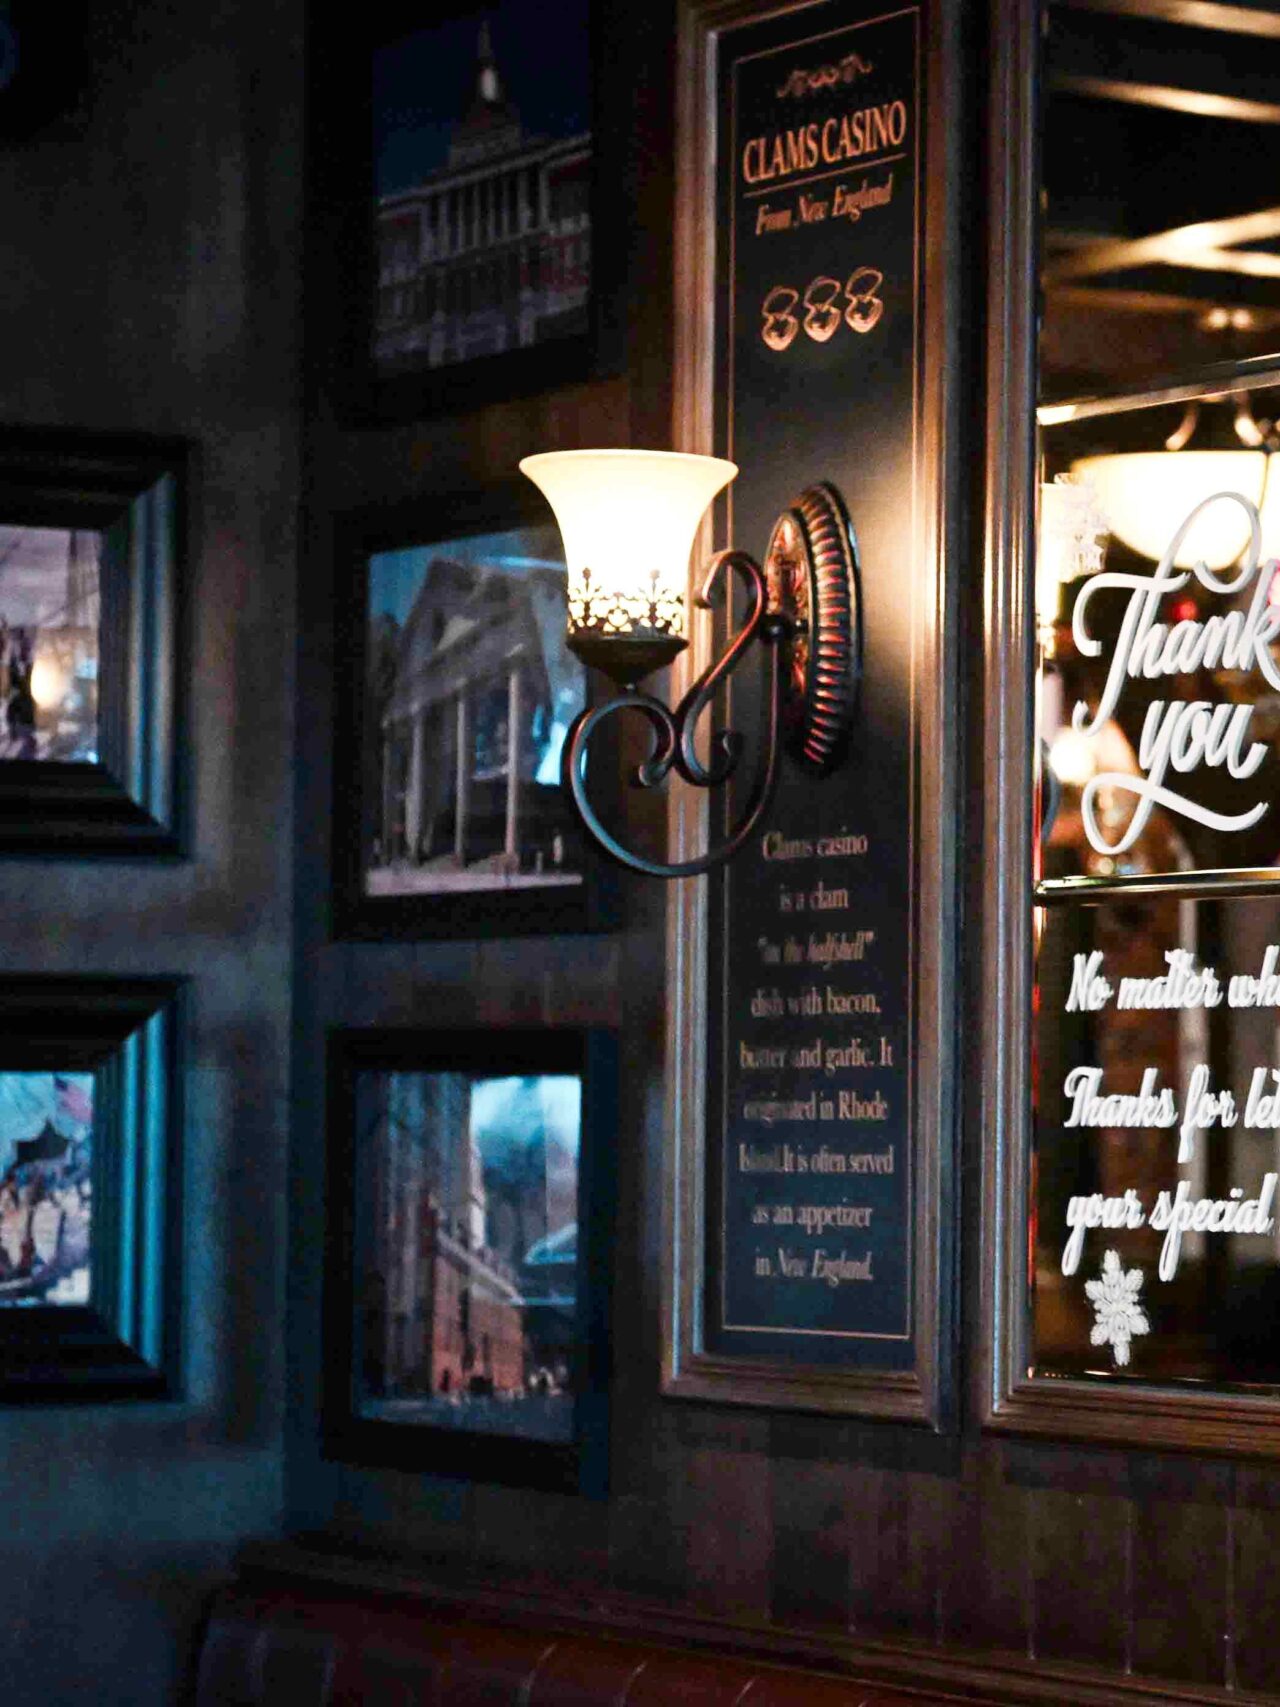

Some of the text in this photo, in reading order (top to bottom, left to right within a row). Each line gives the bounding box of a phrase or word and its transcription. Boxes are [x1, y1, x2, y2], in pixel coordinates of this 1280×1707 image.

[743, 100, 908, 184] CLAMS CASINO
[755, 172, 894, 236] From New England
[1081, 700, 1269, 855] you
[809, 880, 849, 911] clam
[1065, 950, 1114, 1012] No
[1116, 947, 1223, 1010] matter
[1064, 1066, 1178, 1128] Thanks
[1178, 1063, 1238, 1164] for
[753, 1203, 769, 1225] as
[773, 1203, 793, 1226] an
[1062, 1189, 1147, 1276] your
[1149, 1172, 1277, 1282] special
